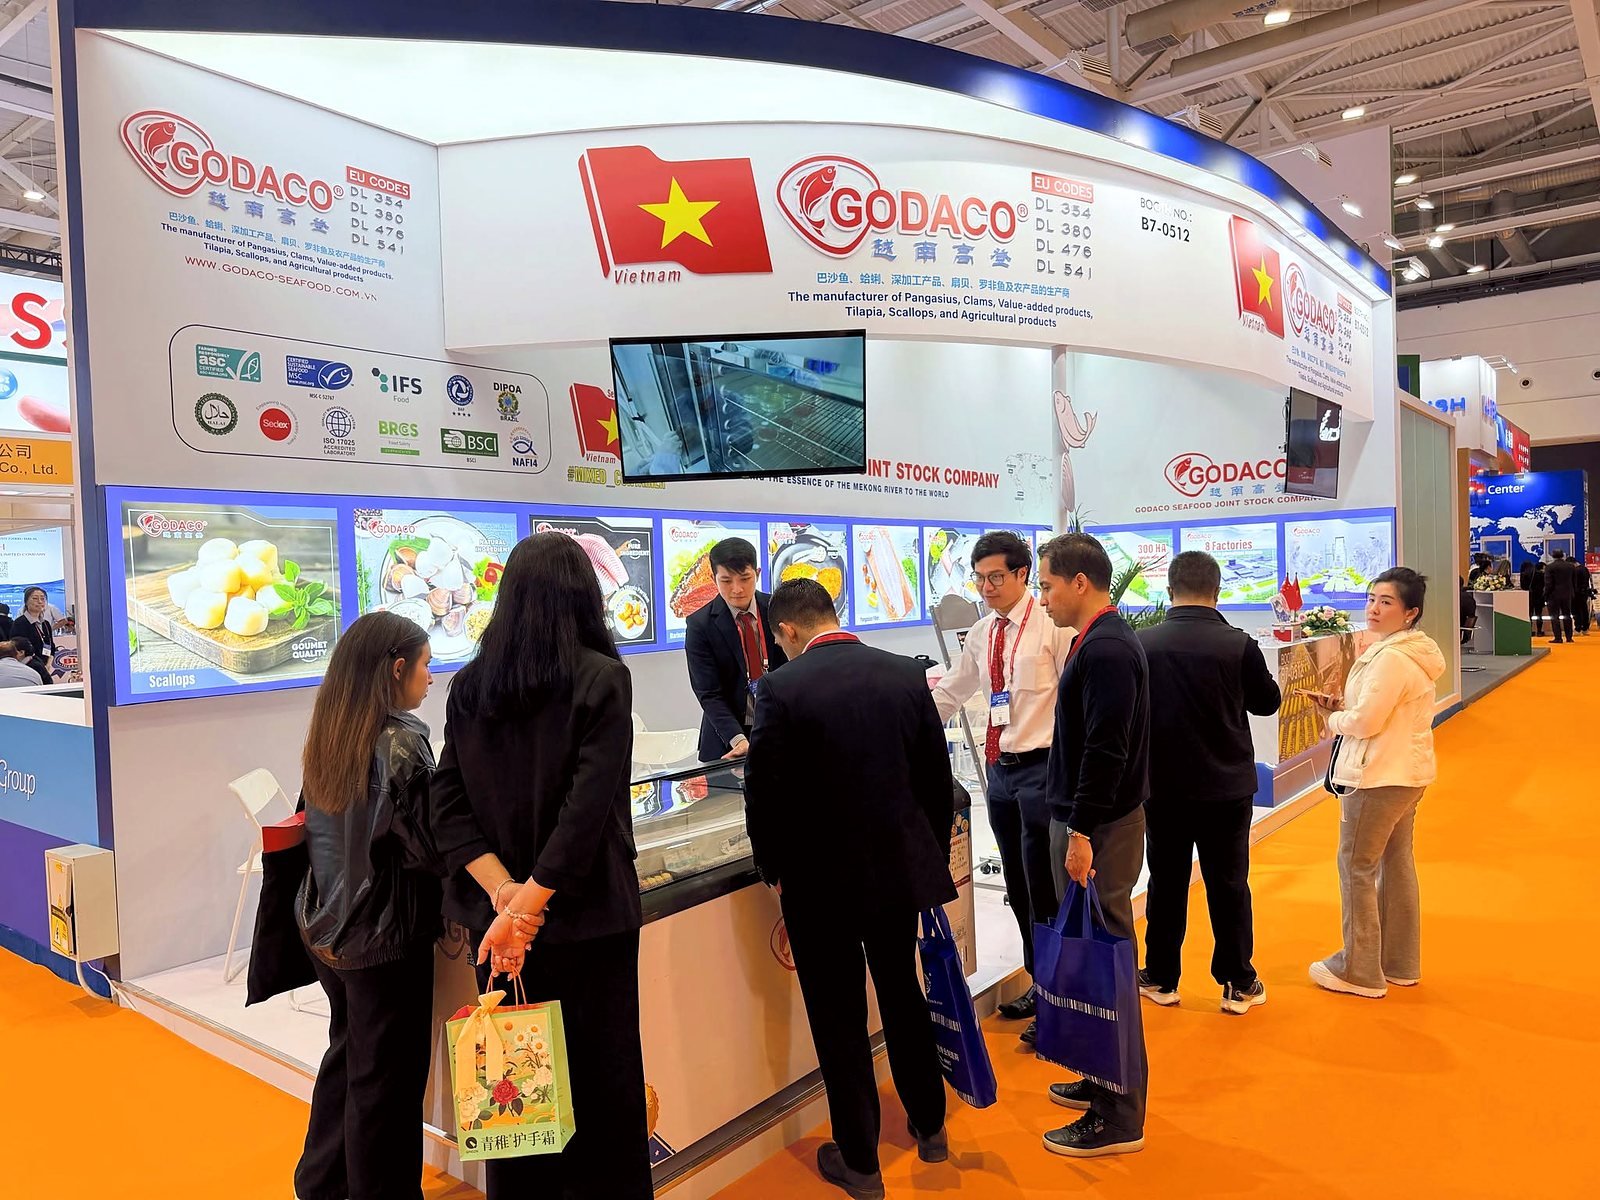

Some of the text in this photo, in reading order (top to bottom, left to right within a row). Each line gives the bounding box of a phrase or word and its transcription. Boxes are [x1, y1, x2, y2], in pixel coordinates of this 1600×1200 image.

[349, 169, 409, 196] EU CODES
[1034, 176, 1093, 199] EU CODES
[350, 186, 403, 209] DL 354
[351, 201, 404, 224] DL 380
[1035, 196, 1091, 219] DL 354
[351, 217, 405, 240] DL 476
[1036, 218, 1091, 240] DL 380
[1141, 216, 1190, 242] B7-0512
[160, 222, 178, 233] The
[179, 228, 236, 245] manufacturer
[237, 240, 246, 248] of
[247, 242, 289, 258] Pangasius,
[290, 251, 315, 263] Clams,
[316, 257, 361, 273] Value-added
[352, 233, 404, 255] DL 541
[1036, 238, 1092, 259] DL 476
[203, 242, 364, 283] Tilapia, Scallops, and Agricultural products
[1037, 259, 1092, 280] DL 541
[614, 269, 681, 284] Vietnam
[787, 290, 1094, 319] The manufacturer of Pangasius, Clams, Value-added products,
[845, 306, 1057, 328] Tilapia, Scallops, and Agricultural products
[198, 355, 226, 367] asc
[287, 356, 309, 364] CERTIFIED
[287, 361, 316, 370] SUSTAINABLE
[288, 366, 309, 374] SEAFOOD
[288, 372, 303, 380] MSC
[392, 375, 423, 395] IFS
[493, 382, 522, 394] DIPOA
[393, 395, 410, 403] Food
[262, 419, 288, 429] Sedex
[337, 438, 356, 446] 17025
[467, 435, 497, 452] BSCI
[586, 453, 616, 464] Vietnam
[32, 463, 58, 475] Ltd.
[896, 462, 941, 483] STOCK
[944, 469, 1000, 489] COMPANY
[787, 476, 822, 487] ESSENCE
[824, 479, 834, 487] OF
[837, 481, 851, 490] THE
[853, 482, 882, 492] MEKONG
[884, 485, 903, 494] RIVER
[904, 487, 914, 495] TO
[915, 488, 927, 496] THE
[928, 489, 949, 498] WORLD
[1487, 484, 1525, 495] Center
[1135, 505, 1170, 513] GODACO
[1172, 502, 1212, 511] SEAFOOD
[1214, 499, 1240, 508] JOINT
[1243, 497, 1274, 506] STOCK
[1138, 543, 1167, 554] 300 HA
[1205, 540, 1253, 551] 8 Factories
[292, 640, 328, 651] GOUMET
[292, 649, 328, 659] QUALITY
[149, 673, 196, 688] Scallops
